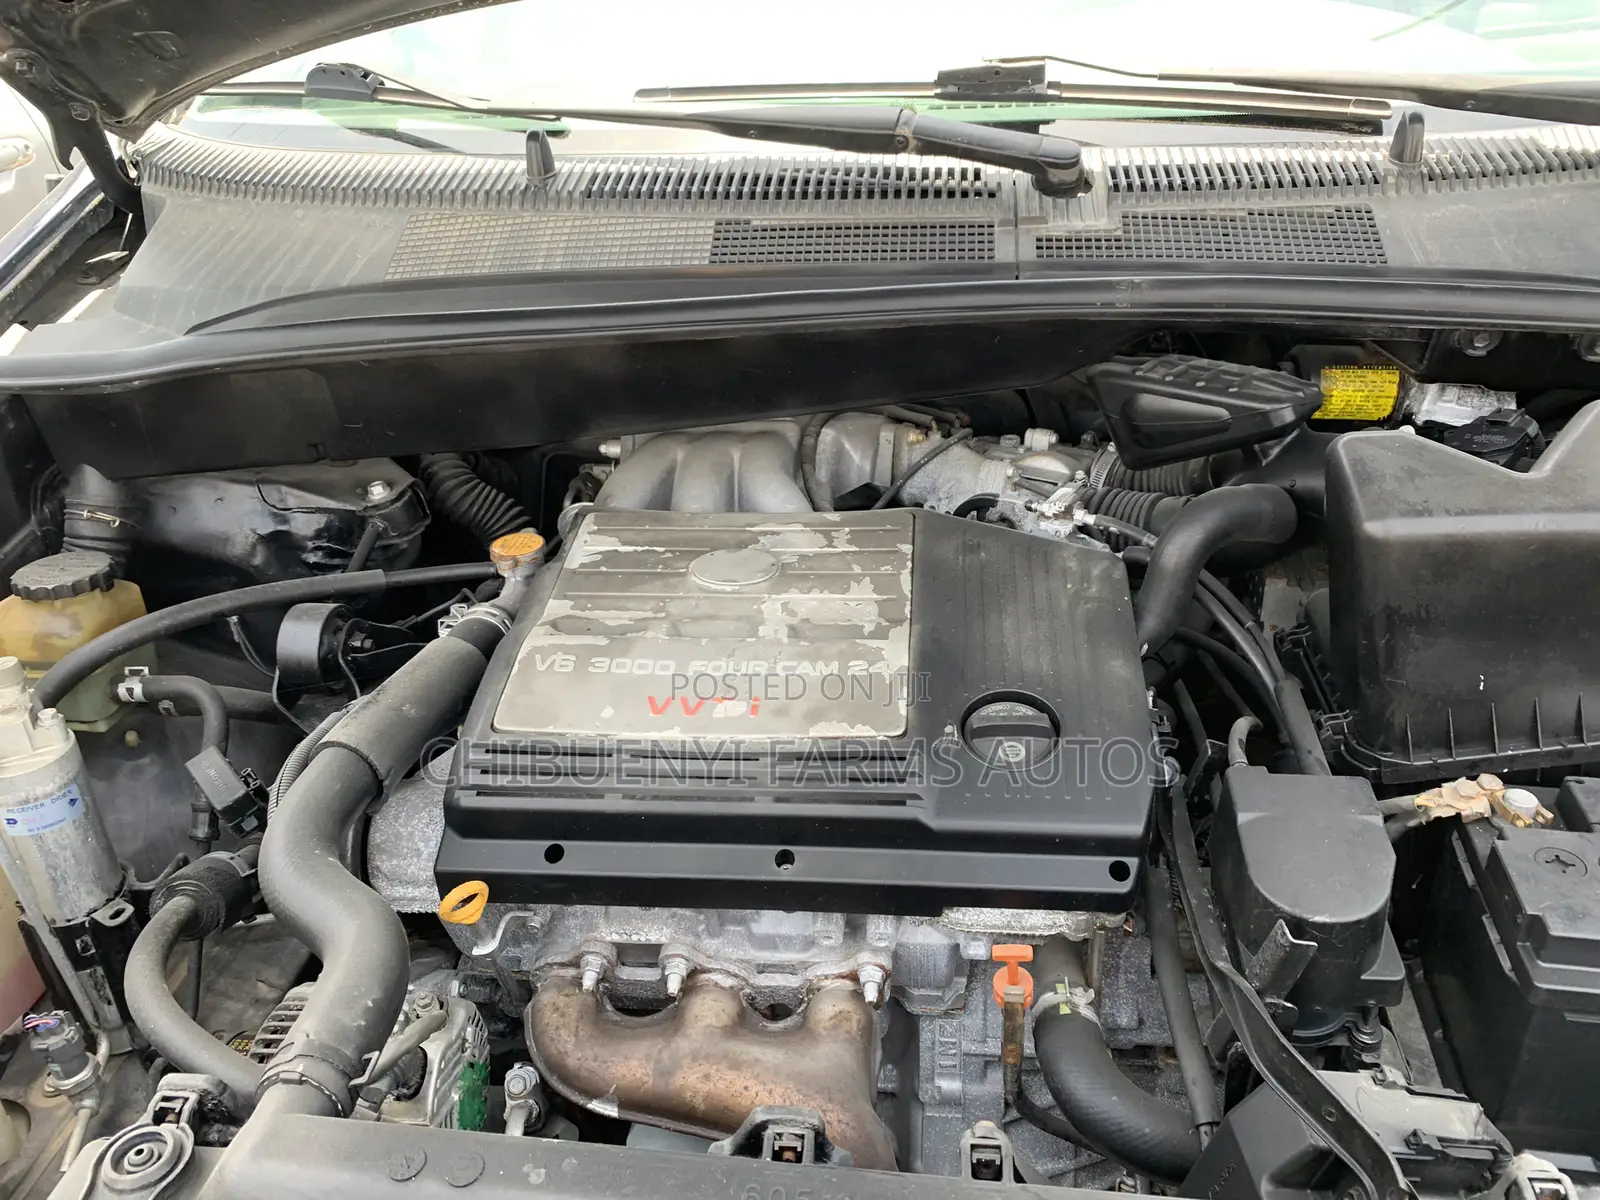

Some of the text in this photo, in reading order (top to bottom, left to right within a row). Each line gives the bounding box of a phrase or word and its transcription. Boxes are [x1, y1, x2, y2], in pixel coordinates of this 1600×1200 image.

[534, 651, 577, 673] V6
[588, 657, 676, 675] 3000
[688, 660, 774, 676] FOUR
[776, 660, 840, 676] CAM
[6, 802, 46, 814] RECEIVER
